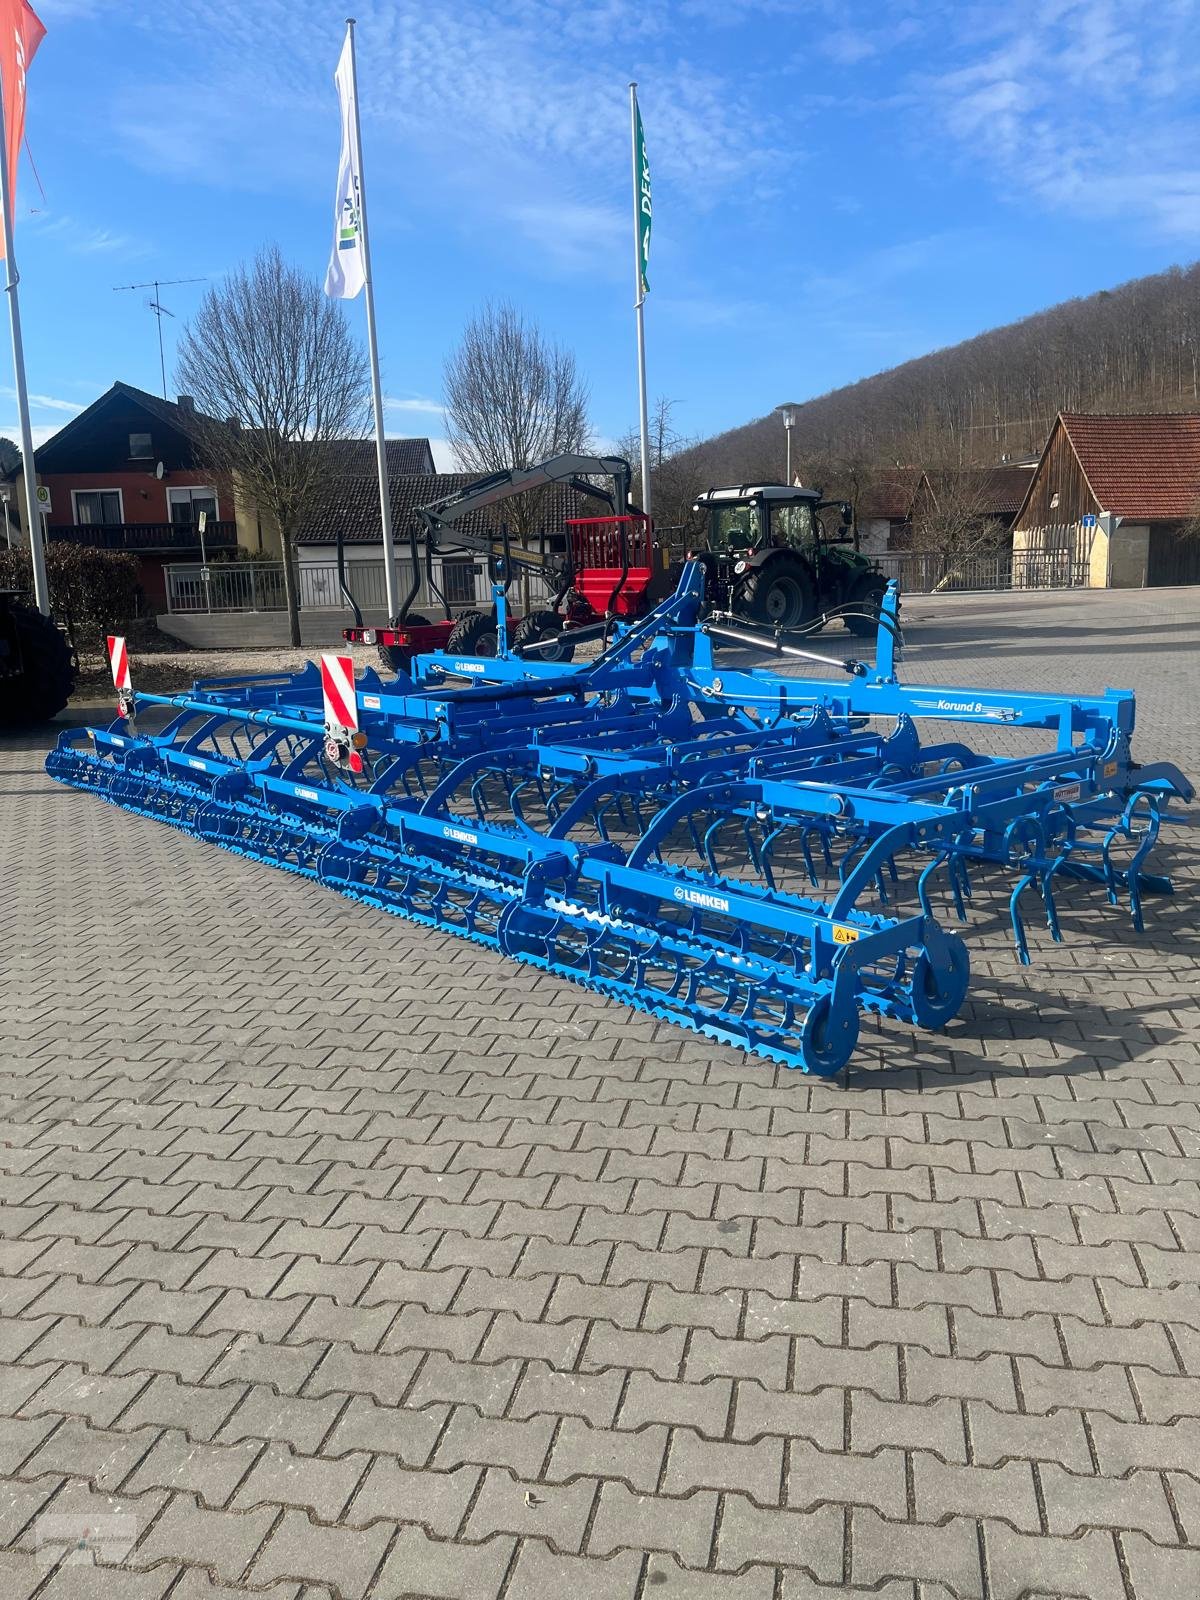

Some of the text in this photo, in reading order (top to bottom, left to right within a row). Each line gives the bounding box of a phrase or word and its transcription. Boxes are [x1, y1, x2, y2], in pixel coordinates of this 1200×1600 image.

[461, 663, 485, 672] LEMKEN
[937, 700, 982, 712] Korund 8
[450, 829, 477, 844] LEMKEN
[684, 889, 729, 912] LEMKEN
